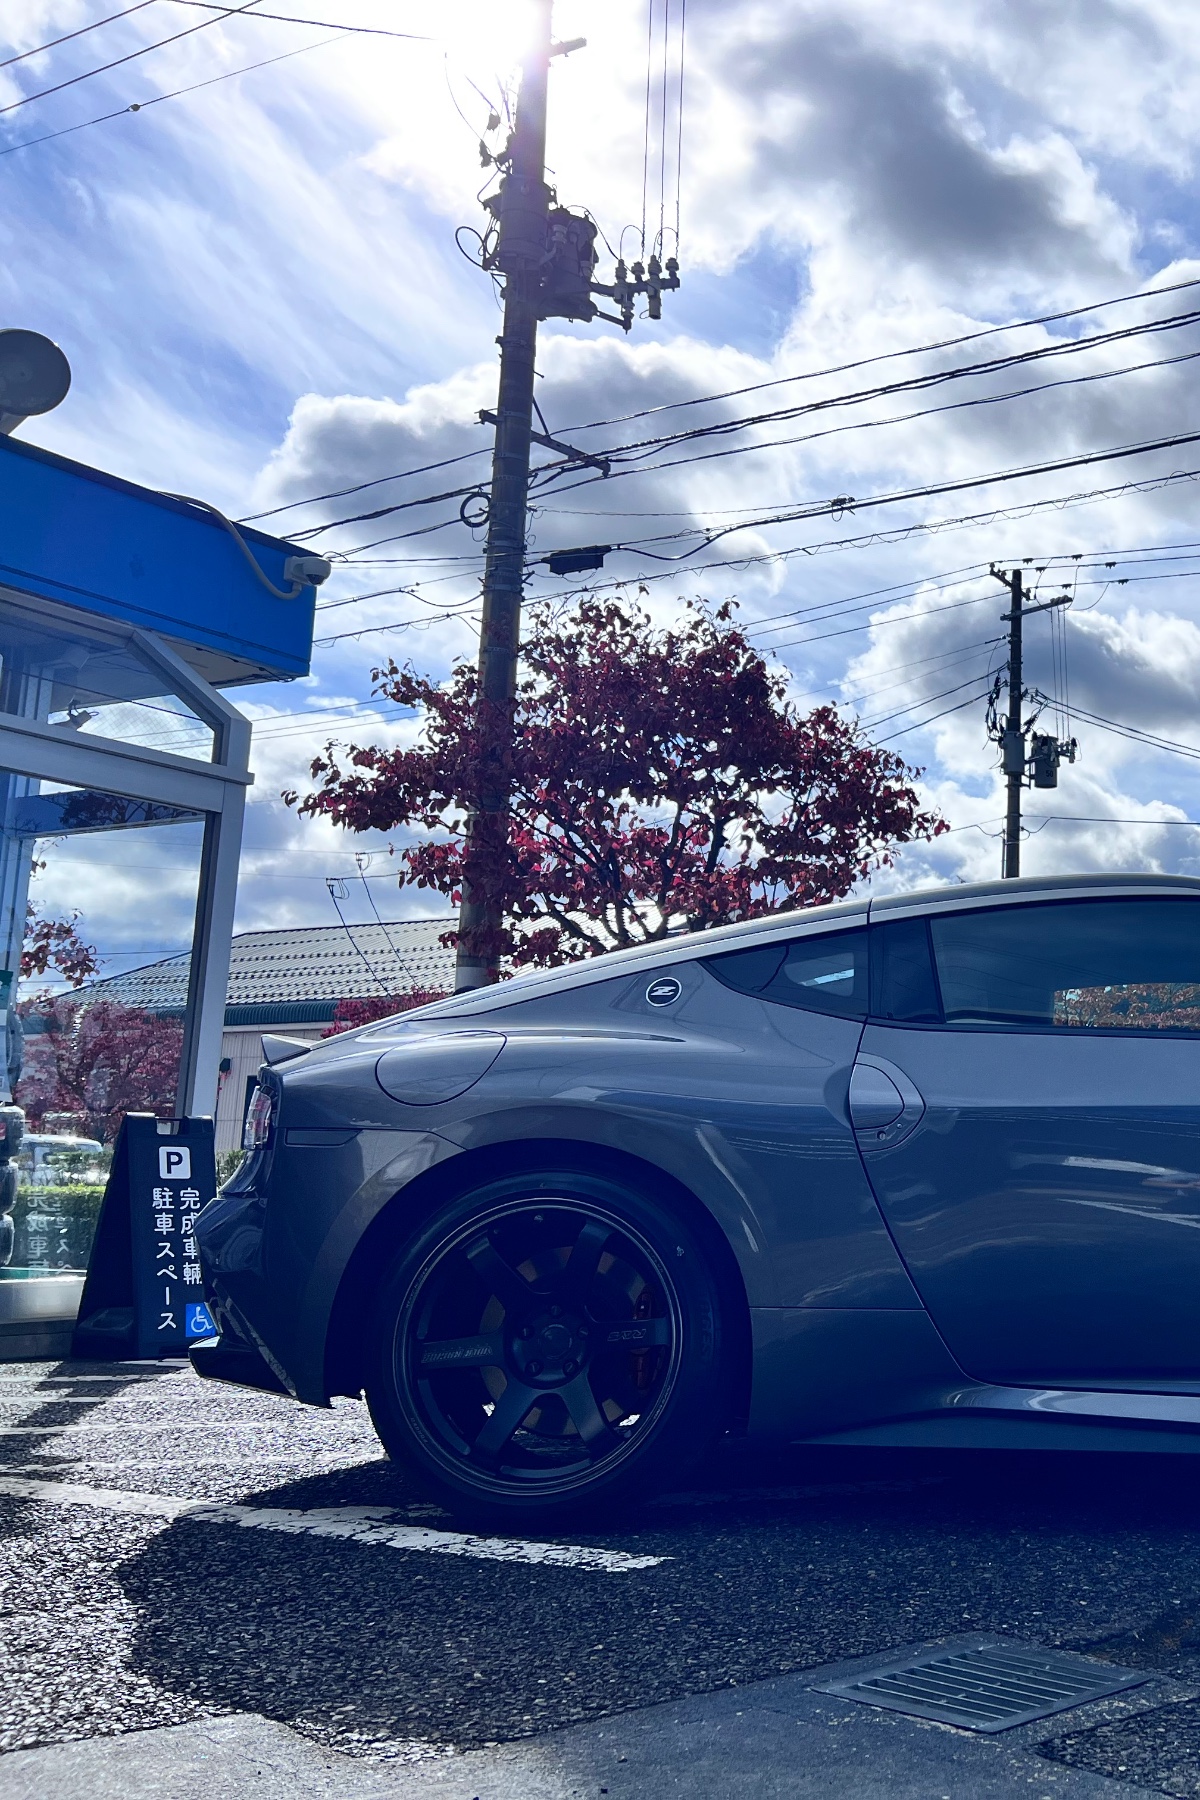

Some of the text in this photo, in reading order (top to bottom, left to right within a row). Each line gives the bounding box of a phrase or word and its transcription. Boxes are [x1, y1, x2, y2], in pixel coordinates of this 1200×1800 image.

[166, 1151, 183, 1174] P
[152, 1187, 178, 1330] 駐車スペース
[607, 1328, 647, 1342] RAYS
